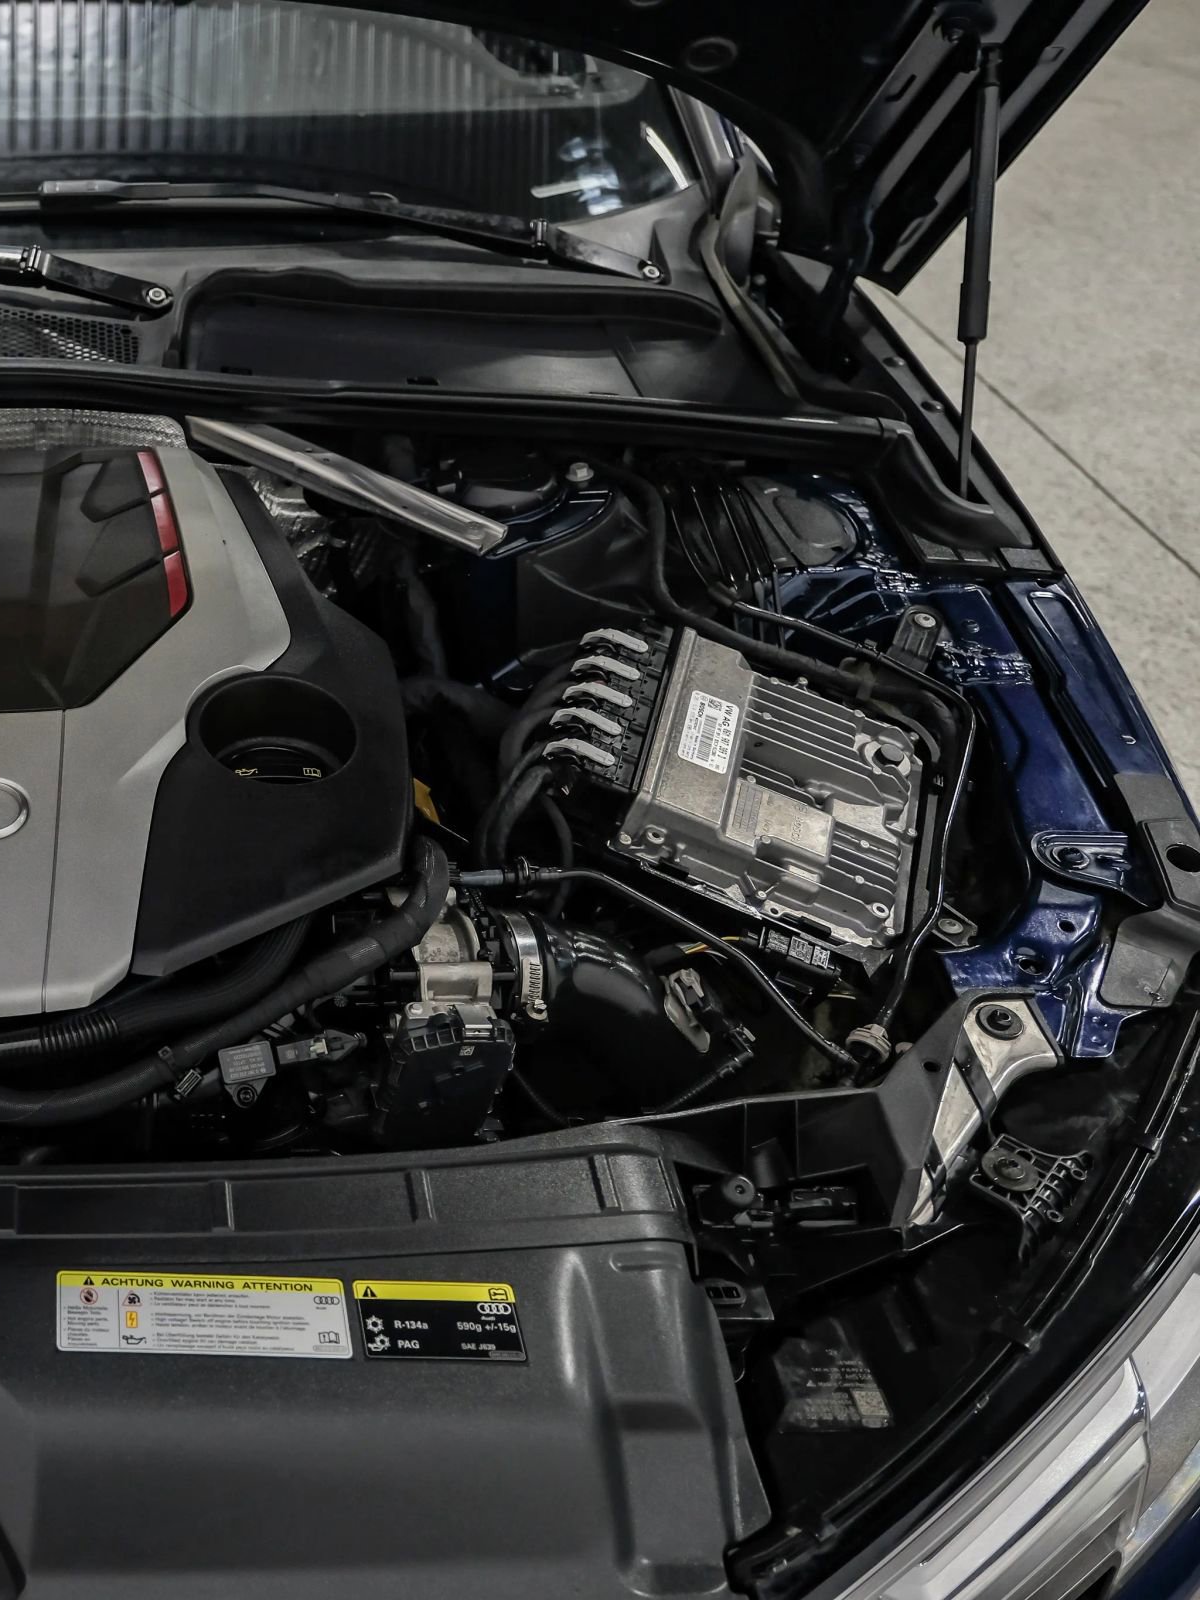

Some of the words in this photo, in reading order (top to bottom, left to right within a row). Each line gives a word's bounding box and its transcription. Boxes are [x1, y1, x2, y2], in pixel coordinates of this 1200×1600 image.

[101, 1277, 164, 1288] ACHTUNG
[171, 1280, 235, 1290] WARNING
[242, 1281, 313, 1292] ATTENTION
[394, 1320, 429, 1330] R-134a
[457, 1321, 482, 1332] 590g
[397, 1340, 420, 1349] PAG
